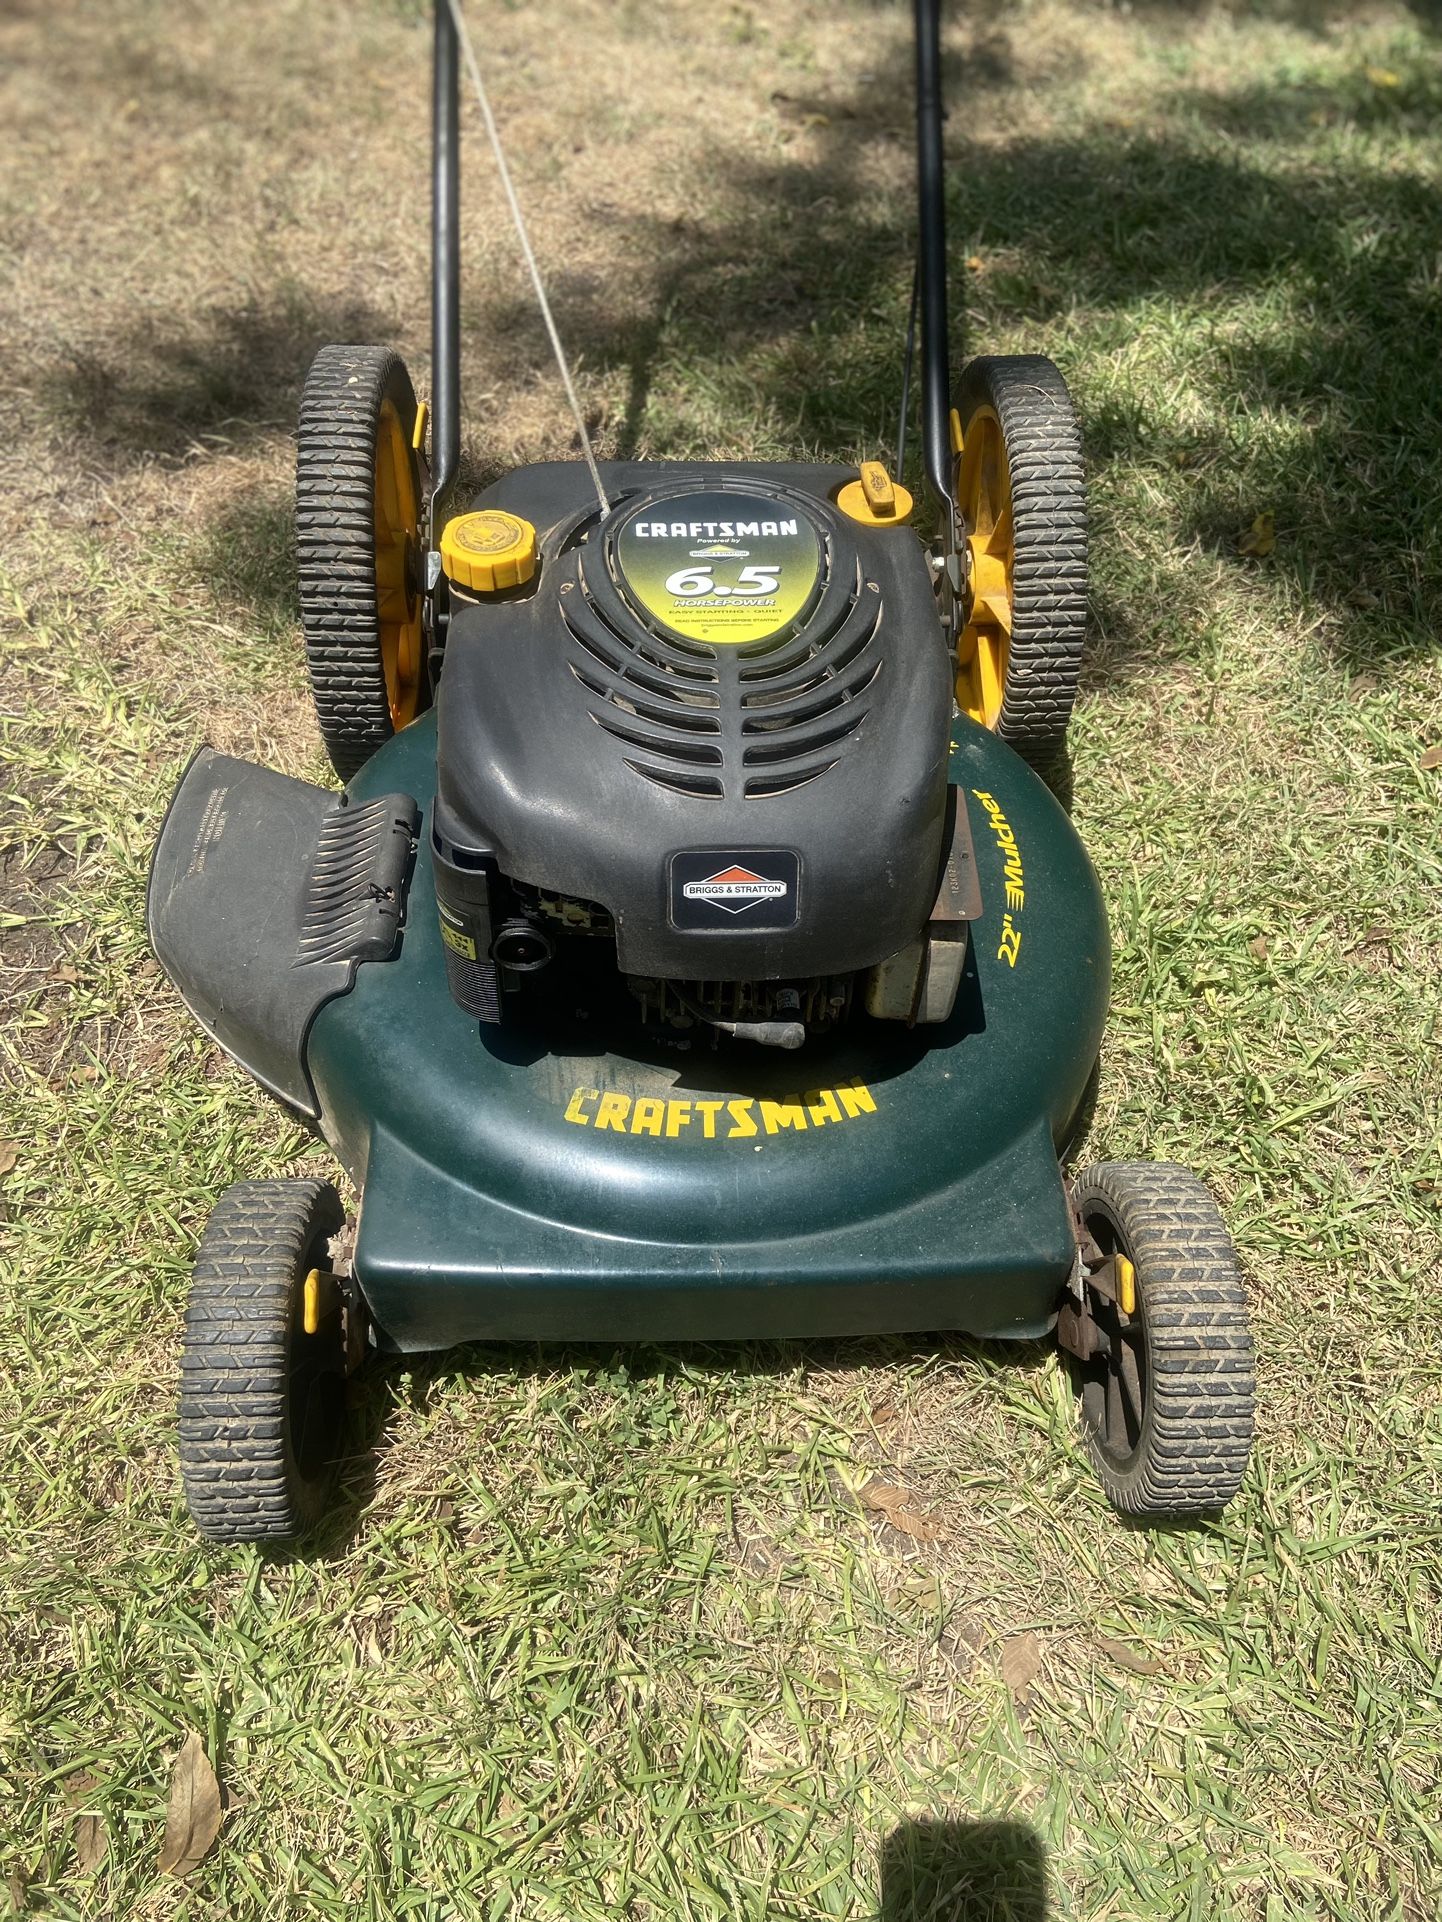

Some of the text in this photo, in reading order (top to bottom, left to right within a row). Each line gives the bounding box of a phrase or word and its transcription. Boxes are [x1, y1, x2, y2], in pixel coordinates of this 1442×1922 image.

[635, 519, 799, 538] CRAFTSMAN
[664, 566, 782, 598] 6.5
[673, 599, 776, 607] HORSEPOWER
[689, 886, 724, 894] BRIGGS
[734, 885, 781, 893] STRATTON
[564, 1076, 877, 1138] CRAFTSMAN
